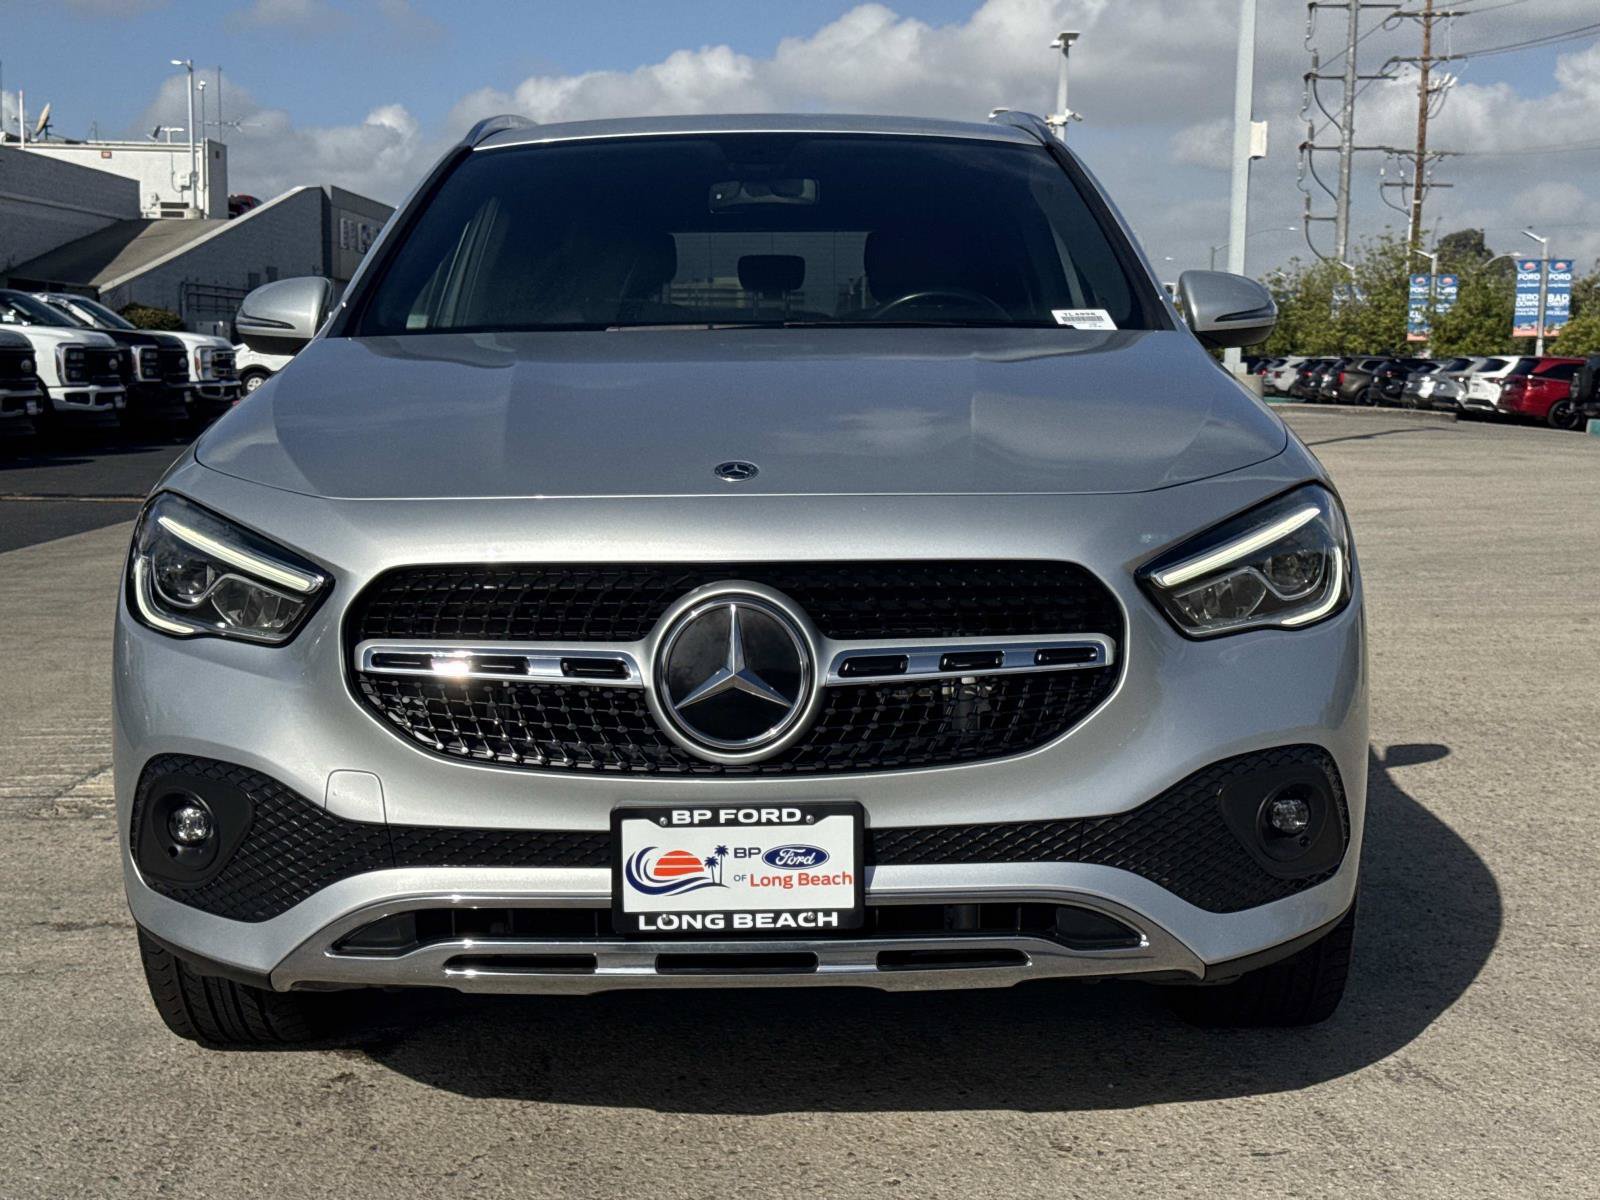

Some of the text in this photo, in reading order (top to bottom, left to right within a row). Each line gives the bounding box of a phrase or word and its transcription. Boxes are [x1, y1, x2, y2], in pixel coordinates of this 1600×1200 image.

[1517, 273, 1541, 281] FORD
[1548, 273, 1572, 281] FORD
[672, 808, 802, 825] BP FORD
[733, 847, 816, 866] BP Ford
[733, 871, 853, 889] OF Long Beach
[638, 911, 838, 931] LONG BEACH
